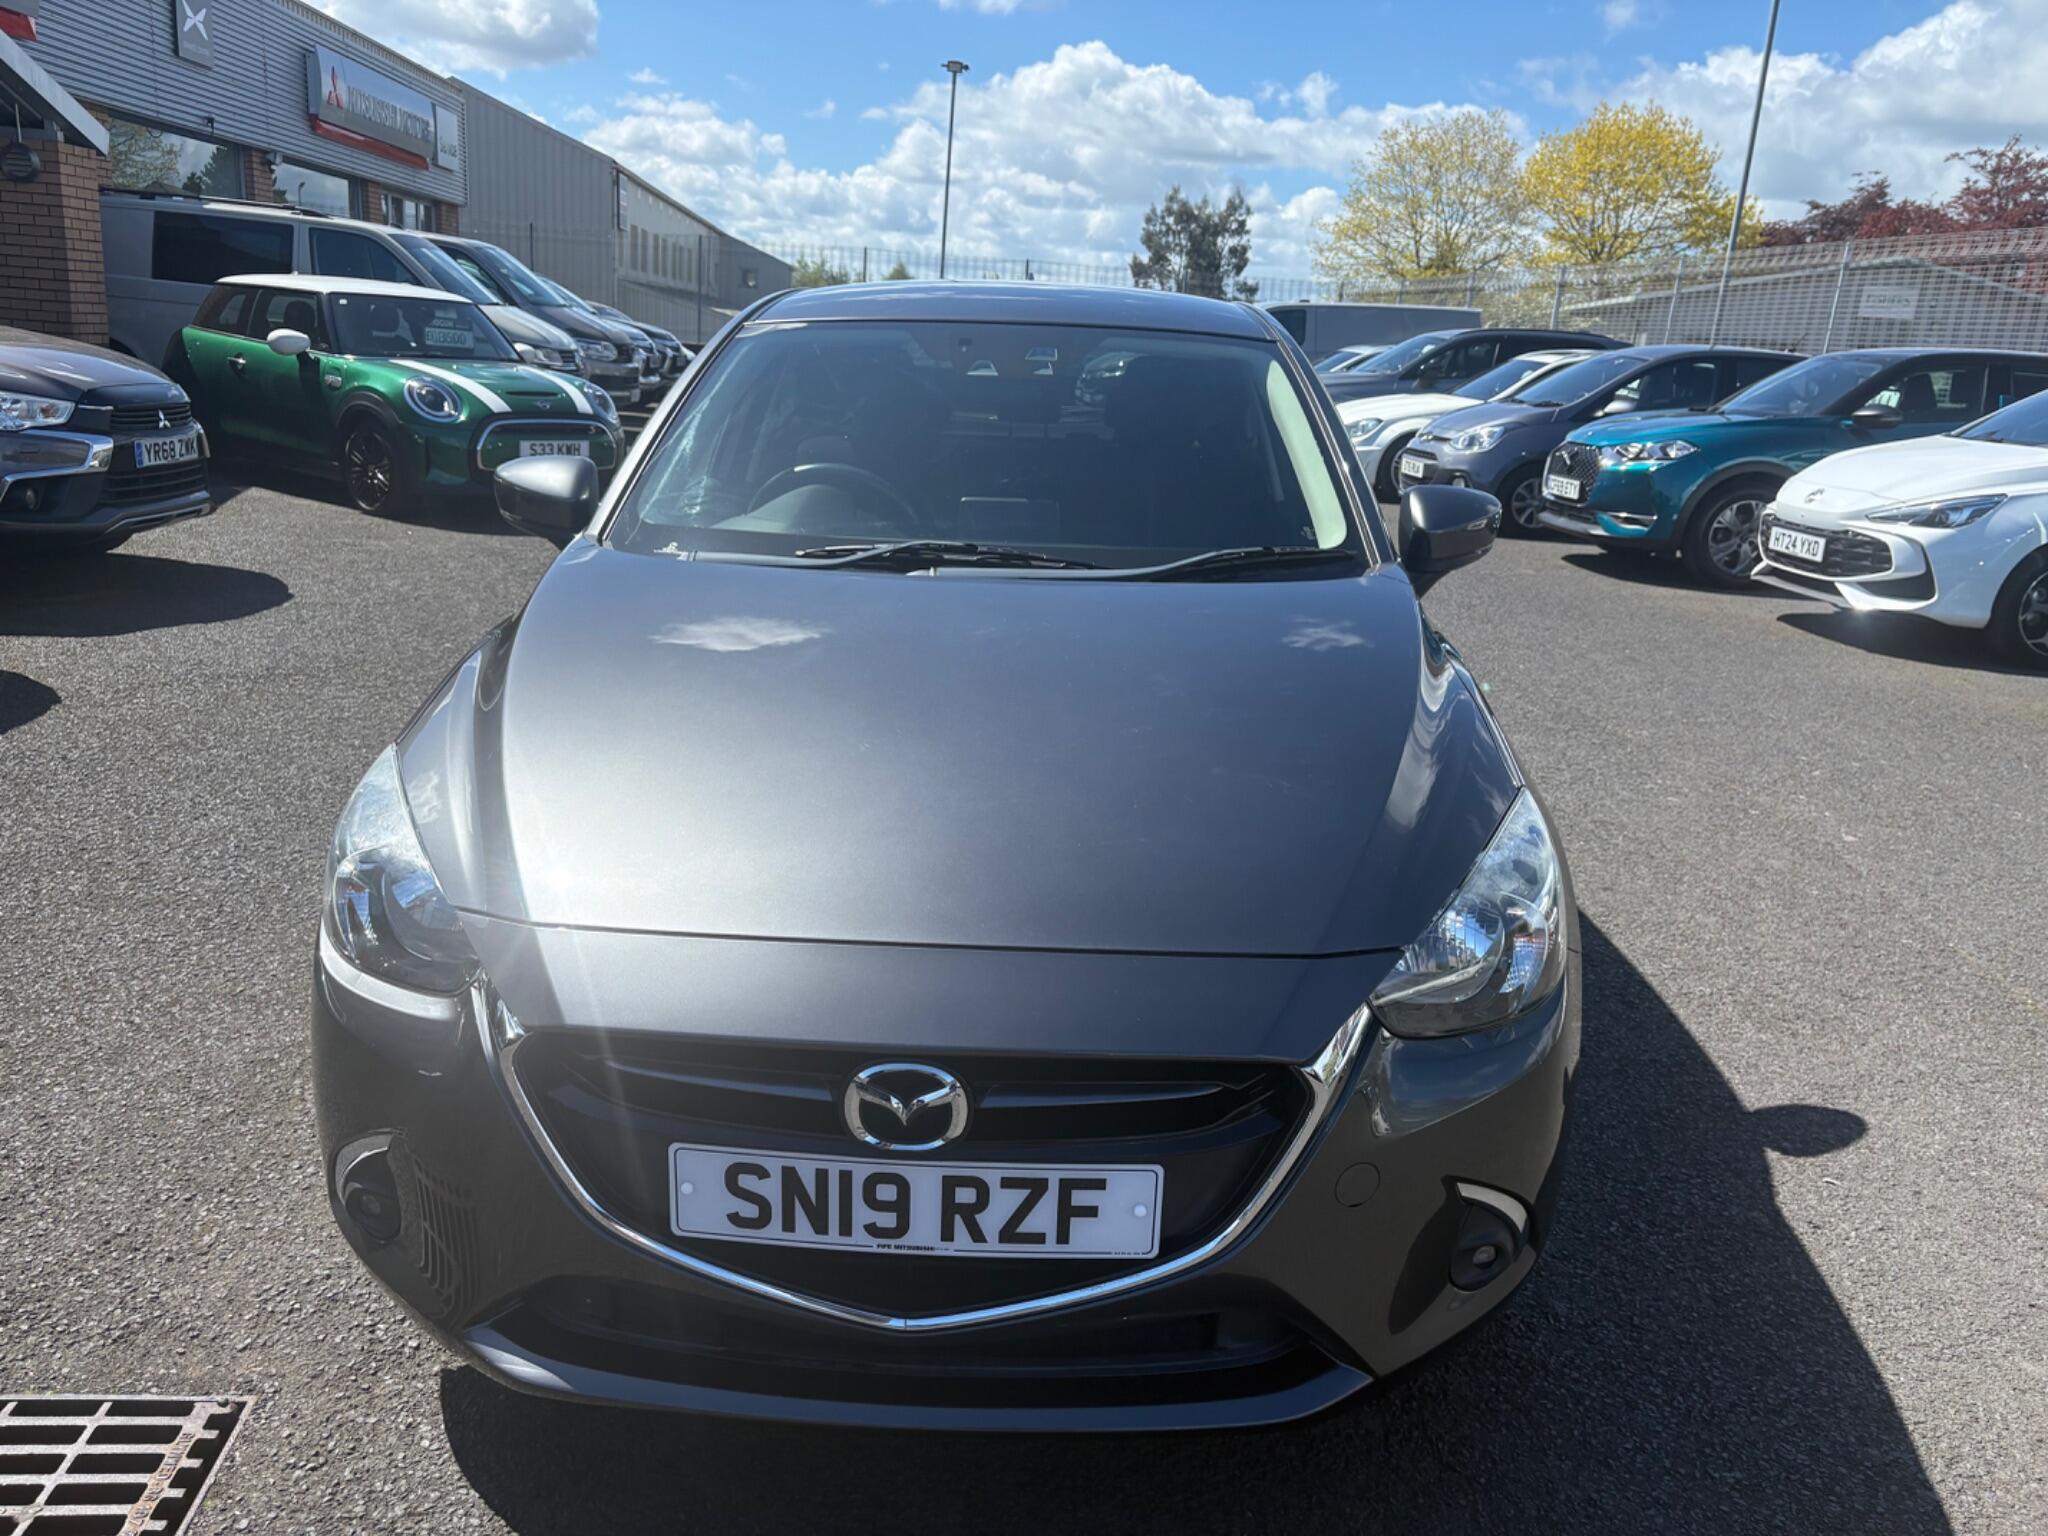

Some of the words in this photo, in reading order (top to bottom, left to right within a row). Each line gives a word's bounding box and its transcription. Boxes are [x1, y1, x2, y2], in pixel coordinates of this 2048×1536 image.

[144, 440, 176, 463] YR68
[529, 442, 554, 456] S33
[1773, 531, 1798, 551] HT24
[1800, 536, 1820, 558] YXD
[724, 1162, 912, 1240] SN19
[940, 1175, 1107, 1245] RZF
